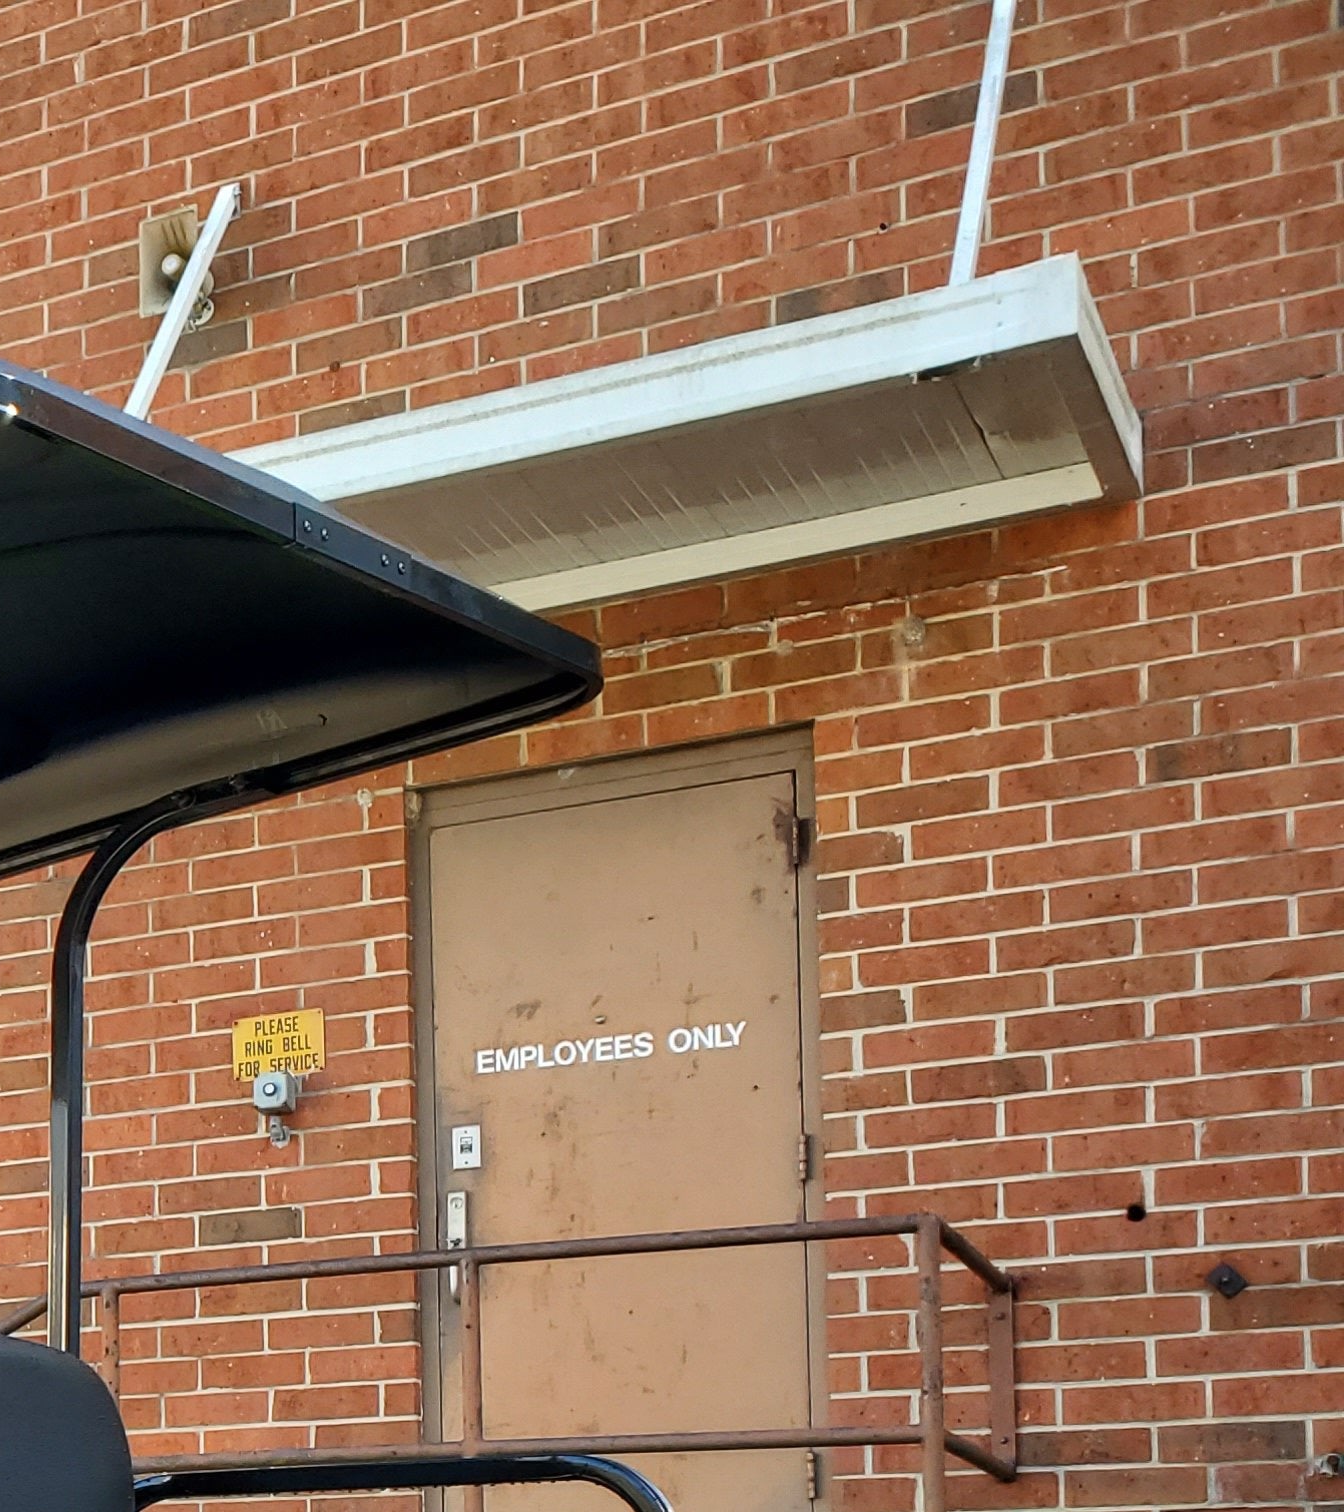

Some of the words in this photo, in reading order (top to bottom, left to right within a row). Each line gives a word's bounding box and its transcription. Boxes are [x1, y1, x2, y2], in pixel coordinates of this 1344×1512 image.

[255, 1016, 299, 1037] PLEASE
[245, 1039, 273, 1058] RING
[282, 1034, 311, 1053] BELL
[476, 1031, 654, 1074] EMPLOYEES
[668, 1021, 746, 1054] ONLY
[238, 1060, 261, 1078] FOR
[269, 1053, 319, 1075] SERVICE
